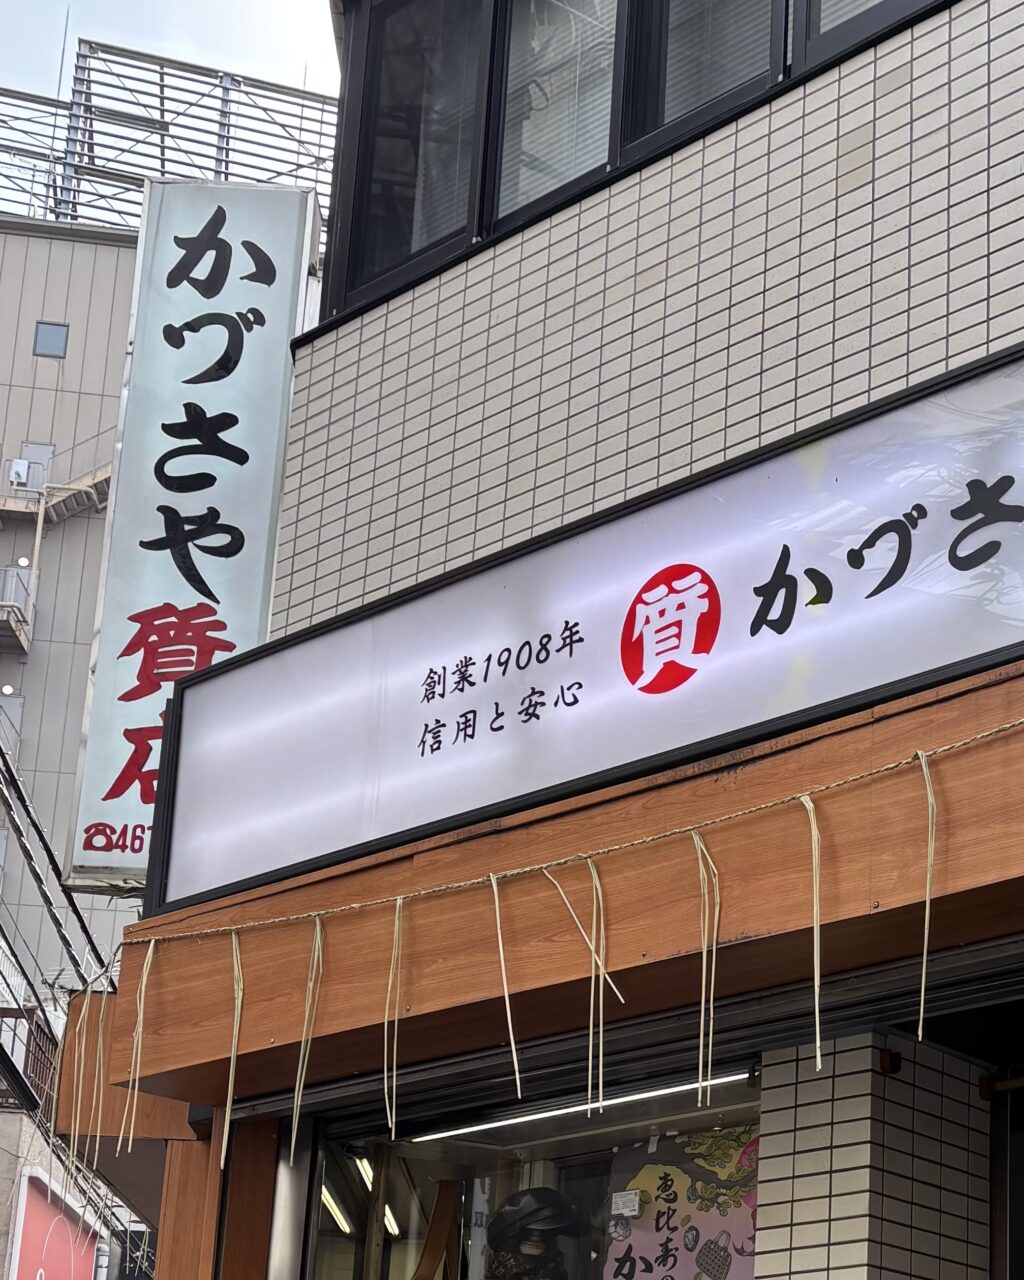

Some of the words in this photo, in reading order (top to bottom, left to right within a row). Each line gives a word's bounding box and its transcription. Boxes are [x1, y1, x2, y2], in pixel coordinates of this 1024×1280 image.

[420, 620, 585, 704] 創業1908年
[417, 681, 584, 758] 信用と安心
[113, 823, 153, 854] 46
